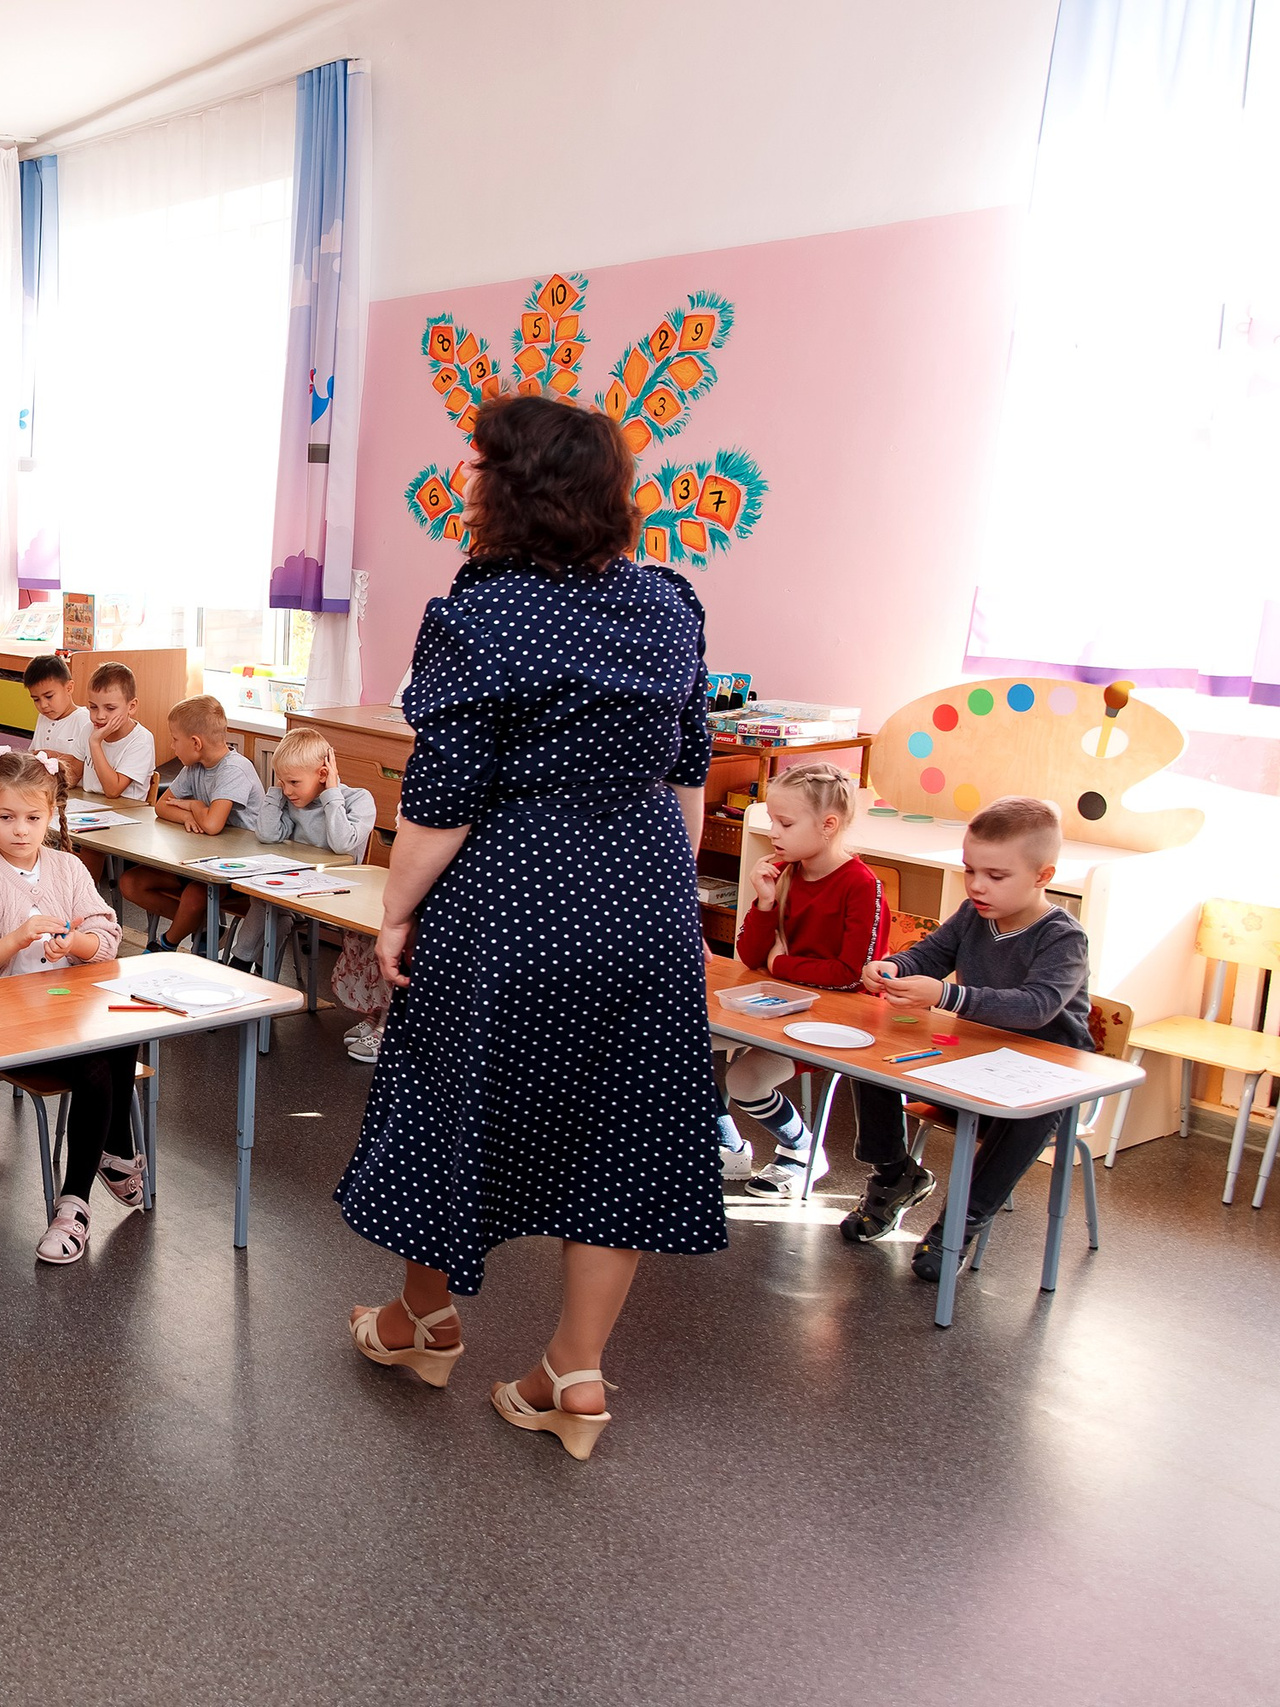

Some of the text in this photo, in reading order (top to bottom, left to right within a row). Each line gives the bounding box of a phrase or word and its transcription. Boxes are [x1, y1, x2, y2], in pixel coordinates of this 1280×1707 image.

[551, 283, 567, 307] 10
[532, 317, 543, 339] 5
[691, 322, 704, 342] 9
[436, 333, 452, 352] 8
[658, 329, 670, 352] 2
[561, 347, 572, 365] 3
[440, 374, 453, 384] 4
[476, 361, 487, 379] 3
[653, 396, 667, 417] 3
[428, 487, 440, 507] 6
[679, 478, 690, 500] 3
[709, 490, 727, 512] 7
